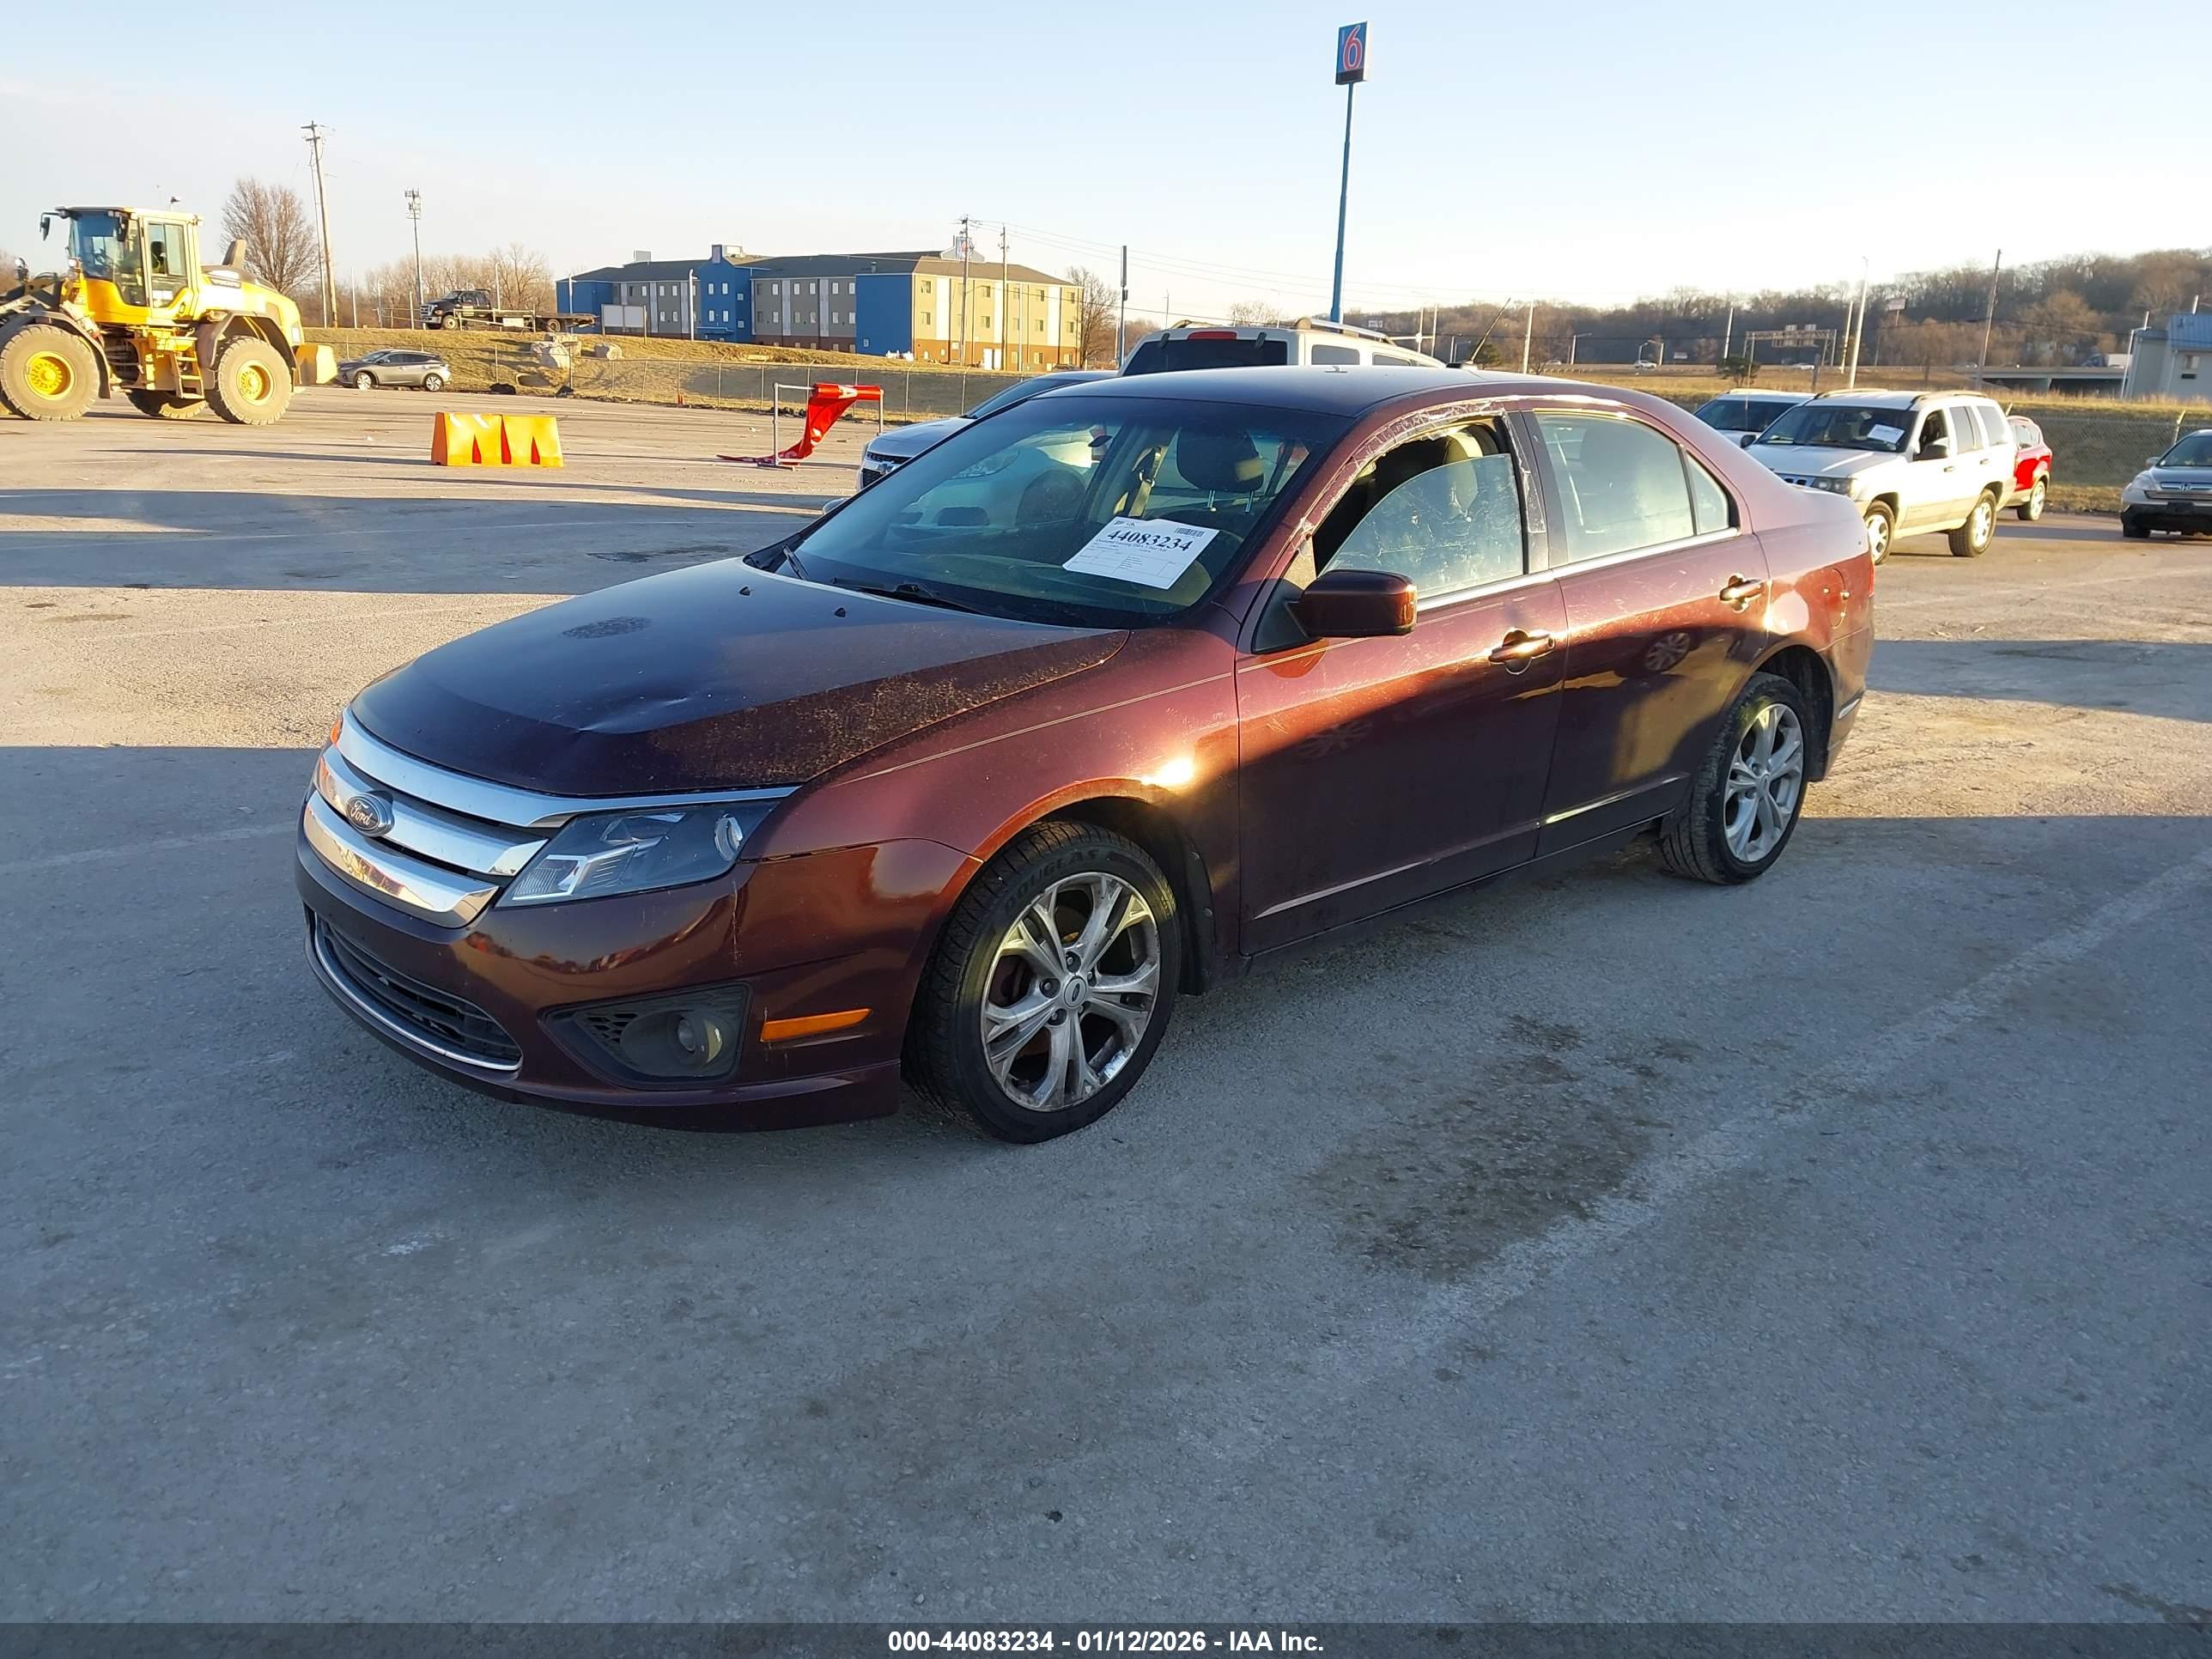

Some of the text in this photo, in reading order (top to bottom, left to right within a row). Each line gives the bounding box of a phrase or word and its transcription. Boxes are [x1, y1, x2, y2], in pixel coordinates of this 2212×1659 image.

[1342, 24, 1363, 70] 6
[1107, 529, 1194, 551] 44083234
[350, 800, 374, 826] Ford
